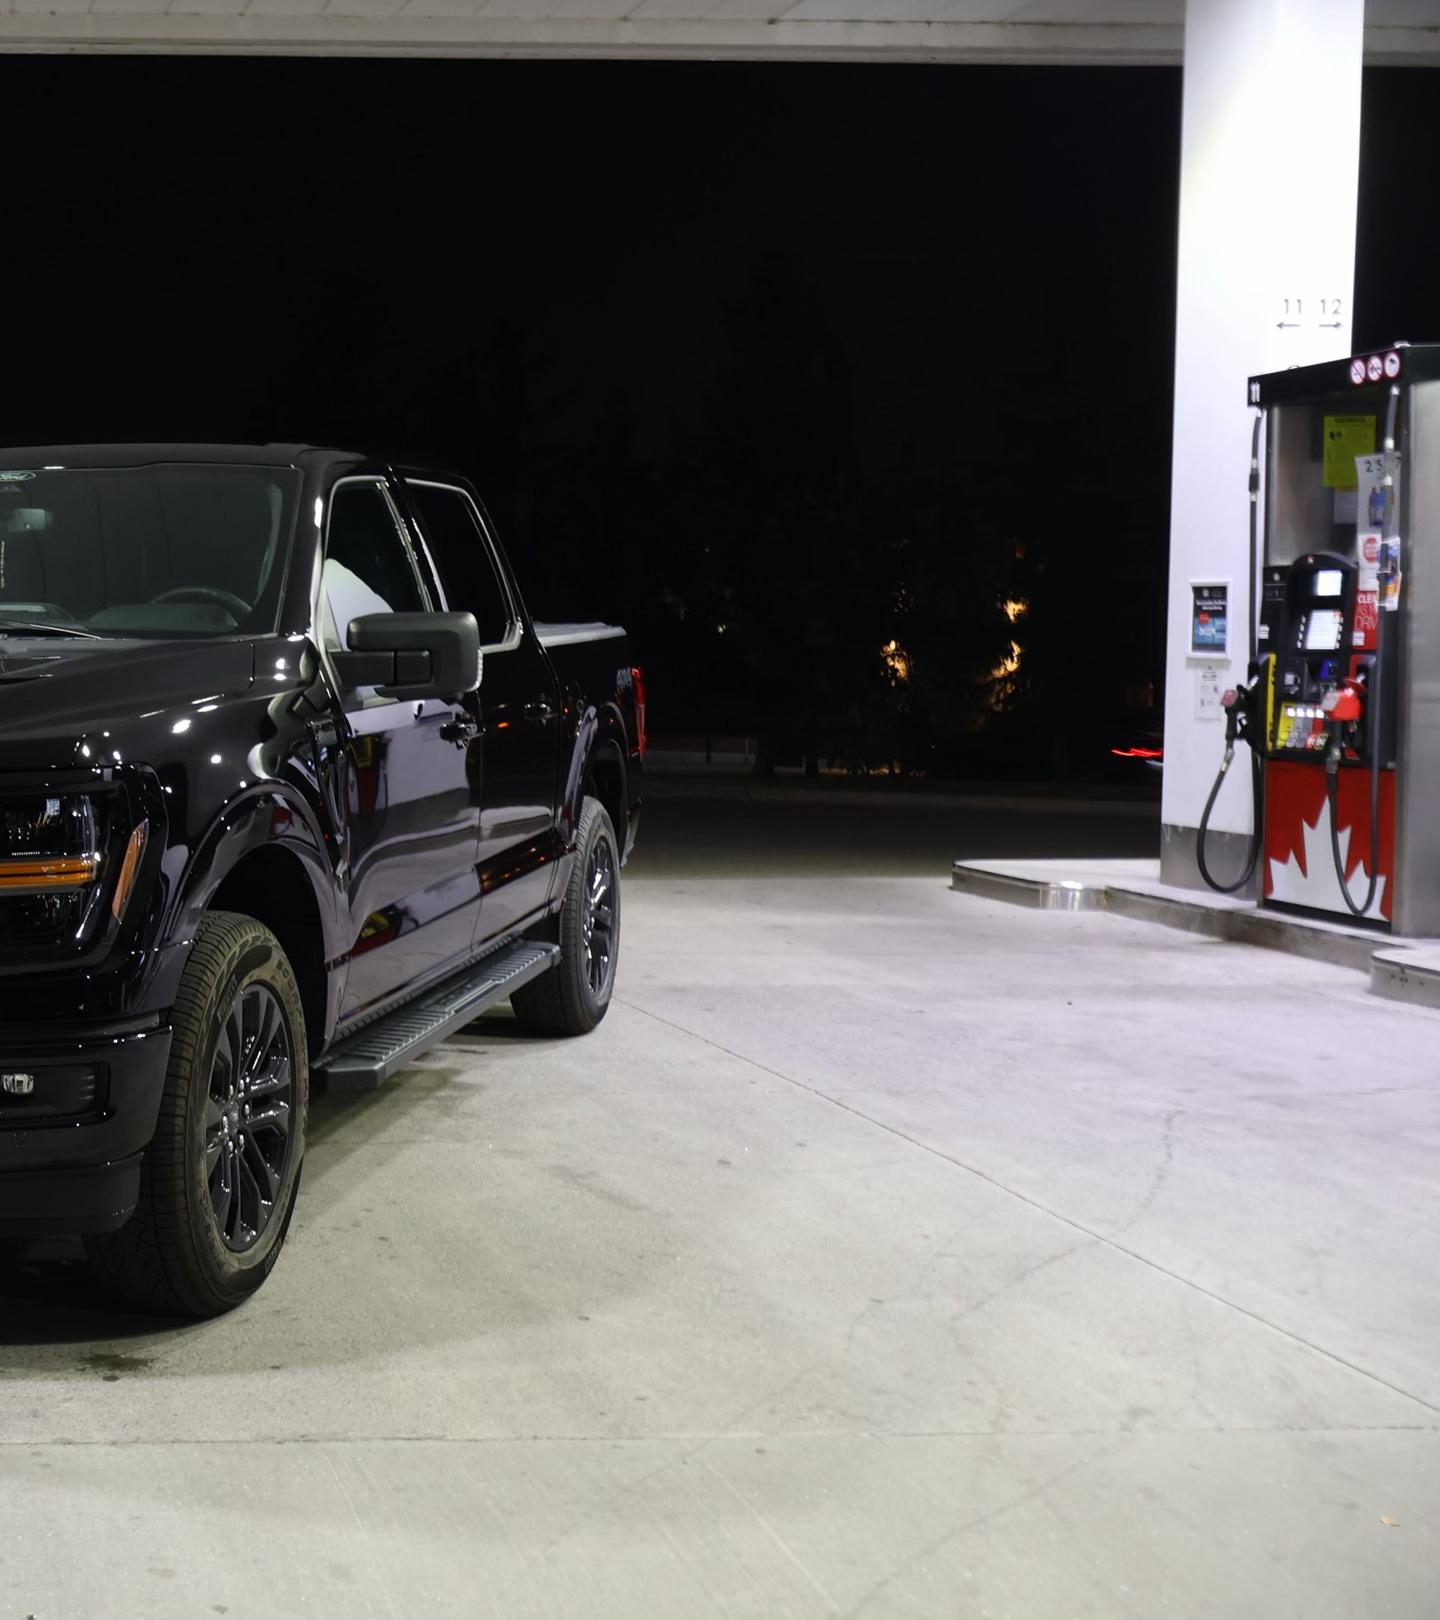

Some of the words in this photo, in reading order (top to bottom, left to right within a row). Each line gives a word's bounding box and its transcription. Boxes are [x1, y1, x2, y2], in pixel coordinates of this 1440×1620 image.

[1283, 298, 1302, 314] 11
[1320, 298, 1342, 315] 12
[1251, 382, 1261, 402] 11
